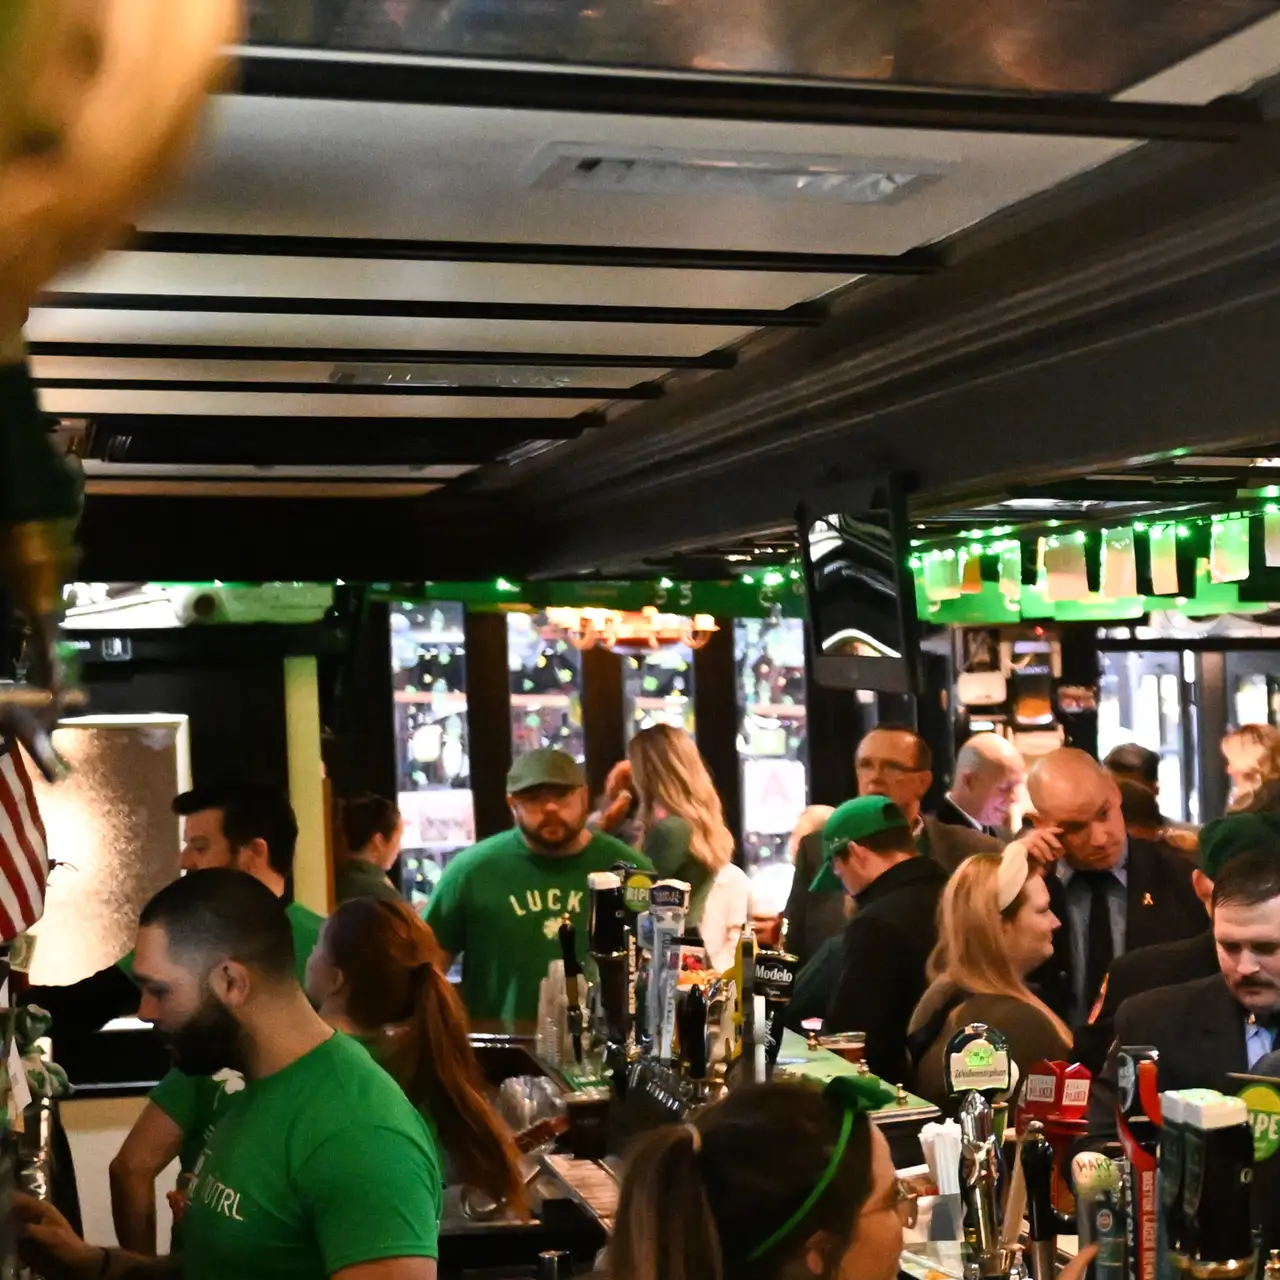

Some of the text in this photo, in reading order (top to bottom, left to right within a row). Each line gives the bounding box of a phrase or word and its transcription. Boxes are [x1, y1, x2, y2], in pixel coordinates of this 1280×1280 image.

[754, 963, 794, 983] Modelo
[1075, 1157, 1113, 1174] HARP
[1142, 1170, 1155, 1211] BOSTON
[1142, 1214, 1156, 1249] LAGER
